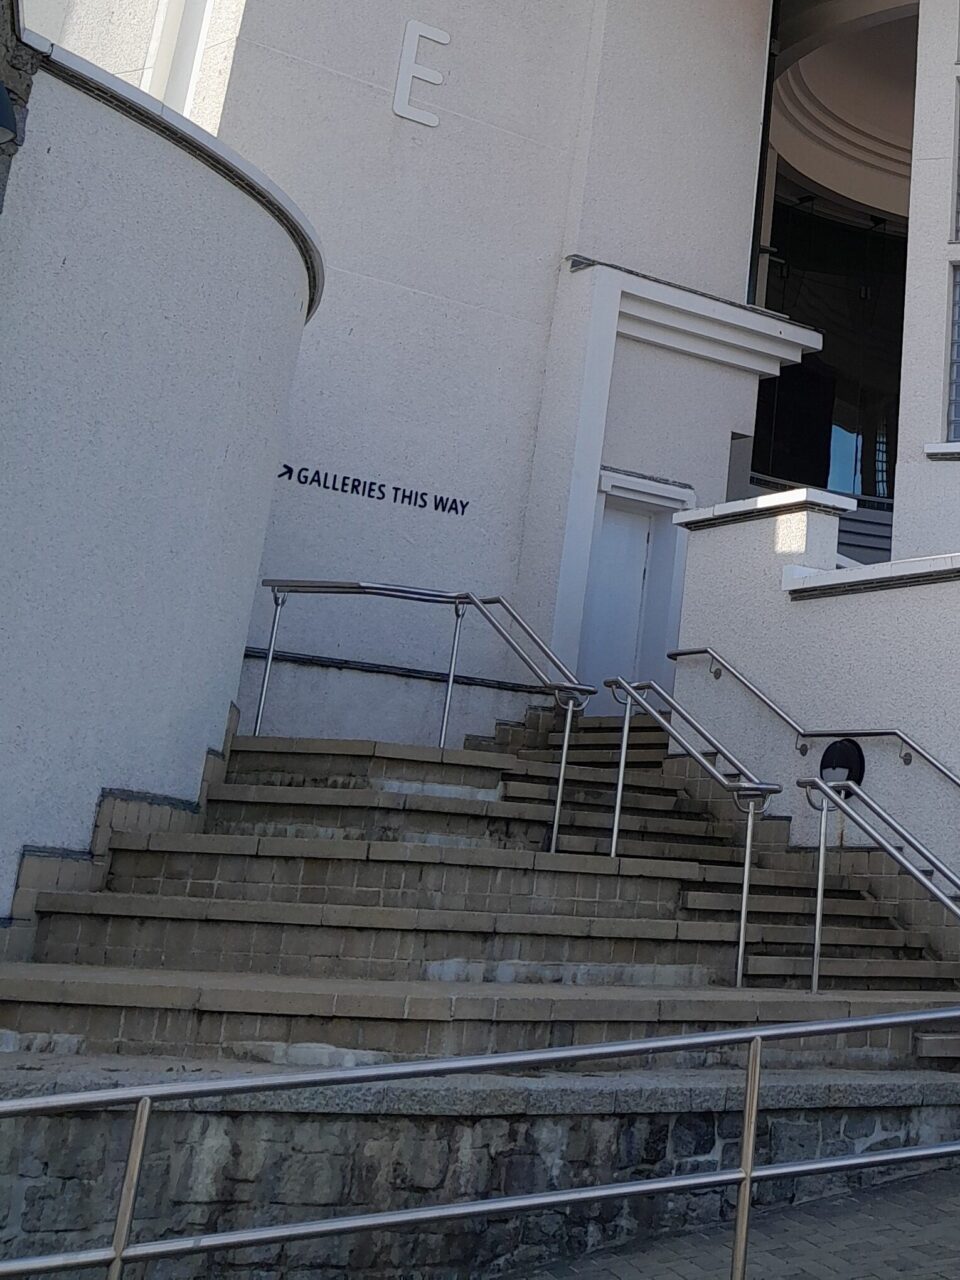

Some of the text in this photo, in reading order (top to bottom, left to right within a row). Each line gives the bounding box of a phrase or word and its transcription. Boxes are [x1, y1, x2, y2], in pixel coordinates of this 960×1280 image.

[297, 467, 470, 516] GALLERIES THIS WAY
